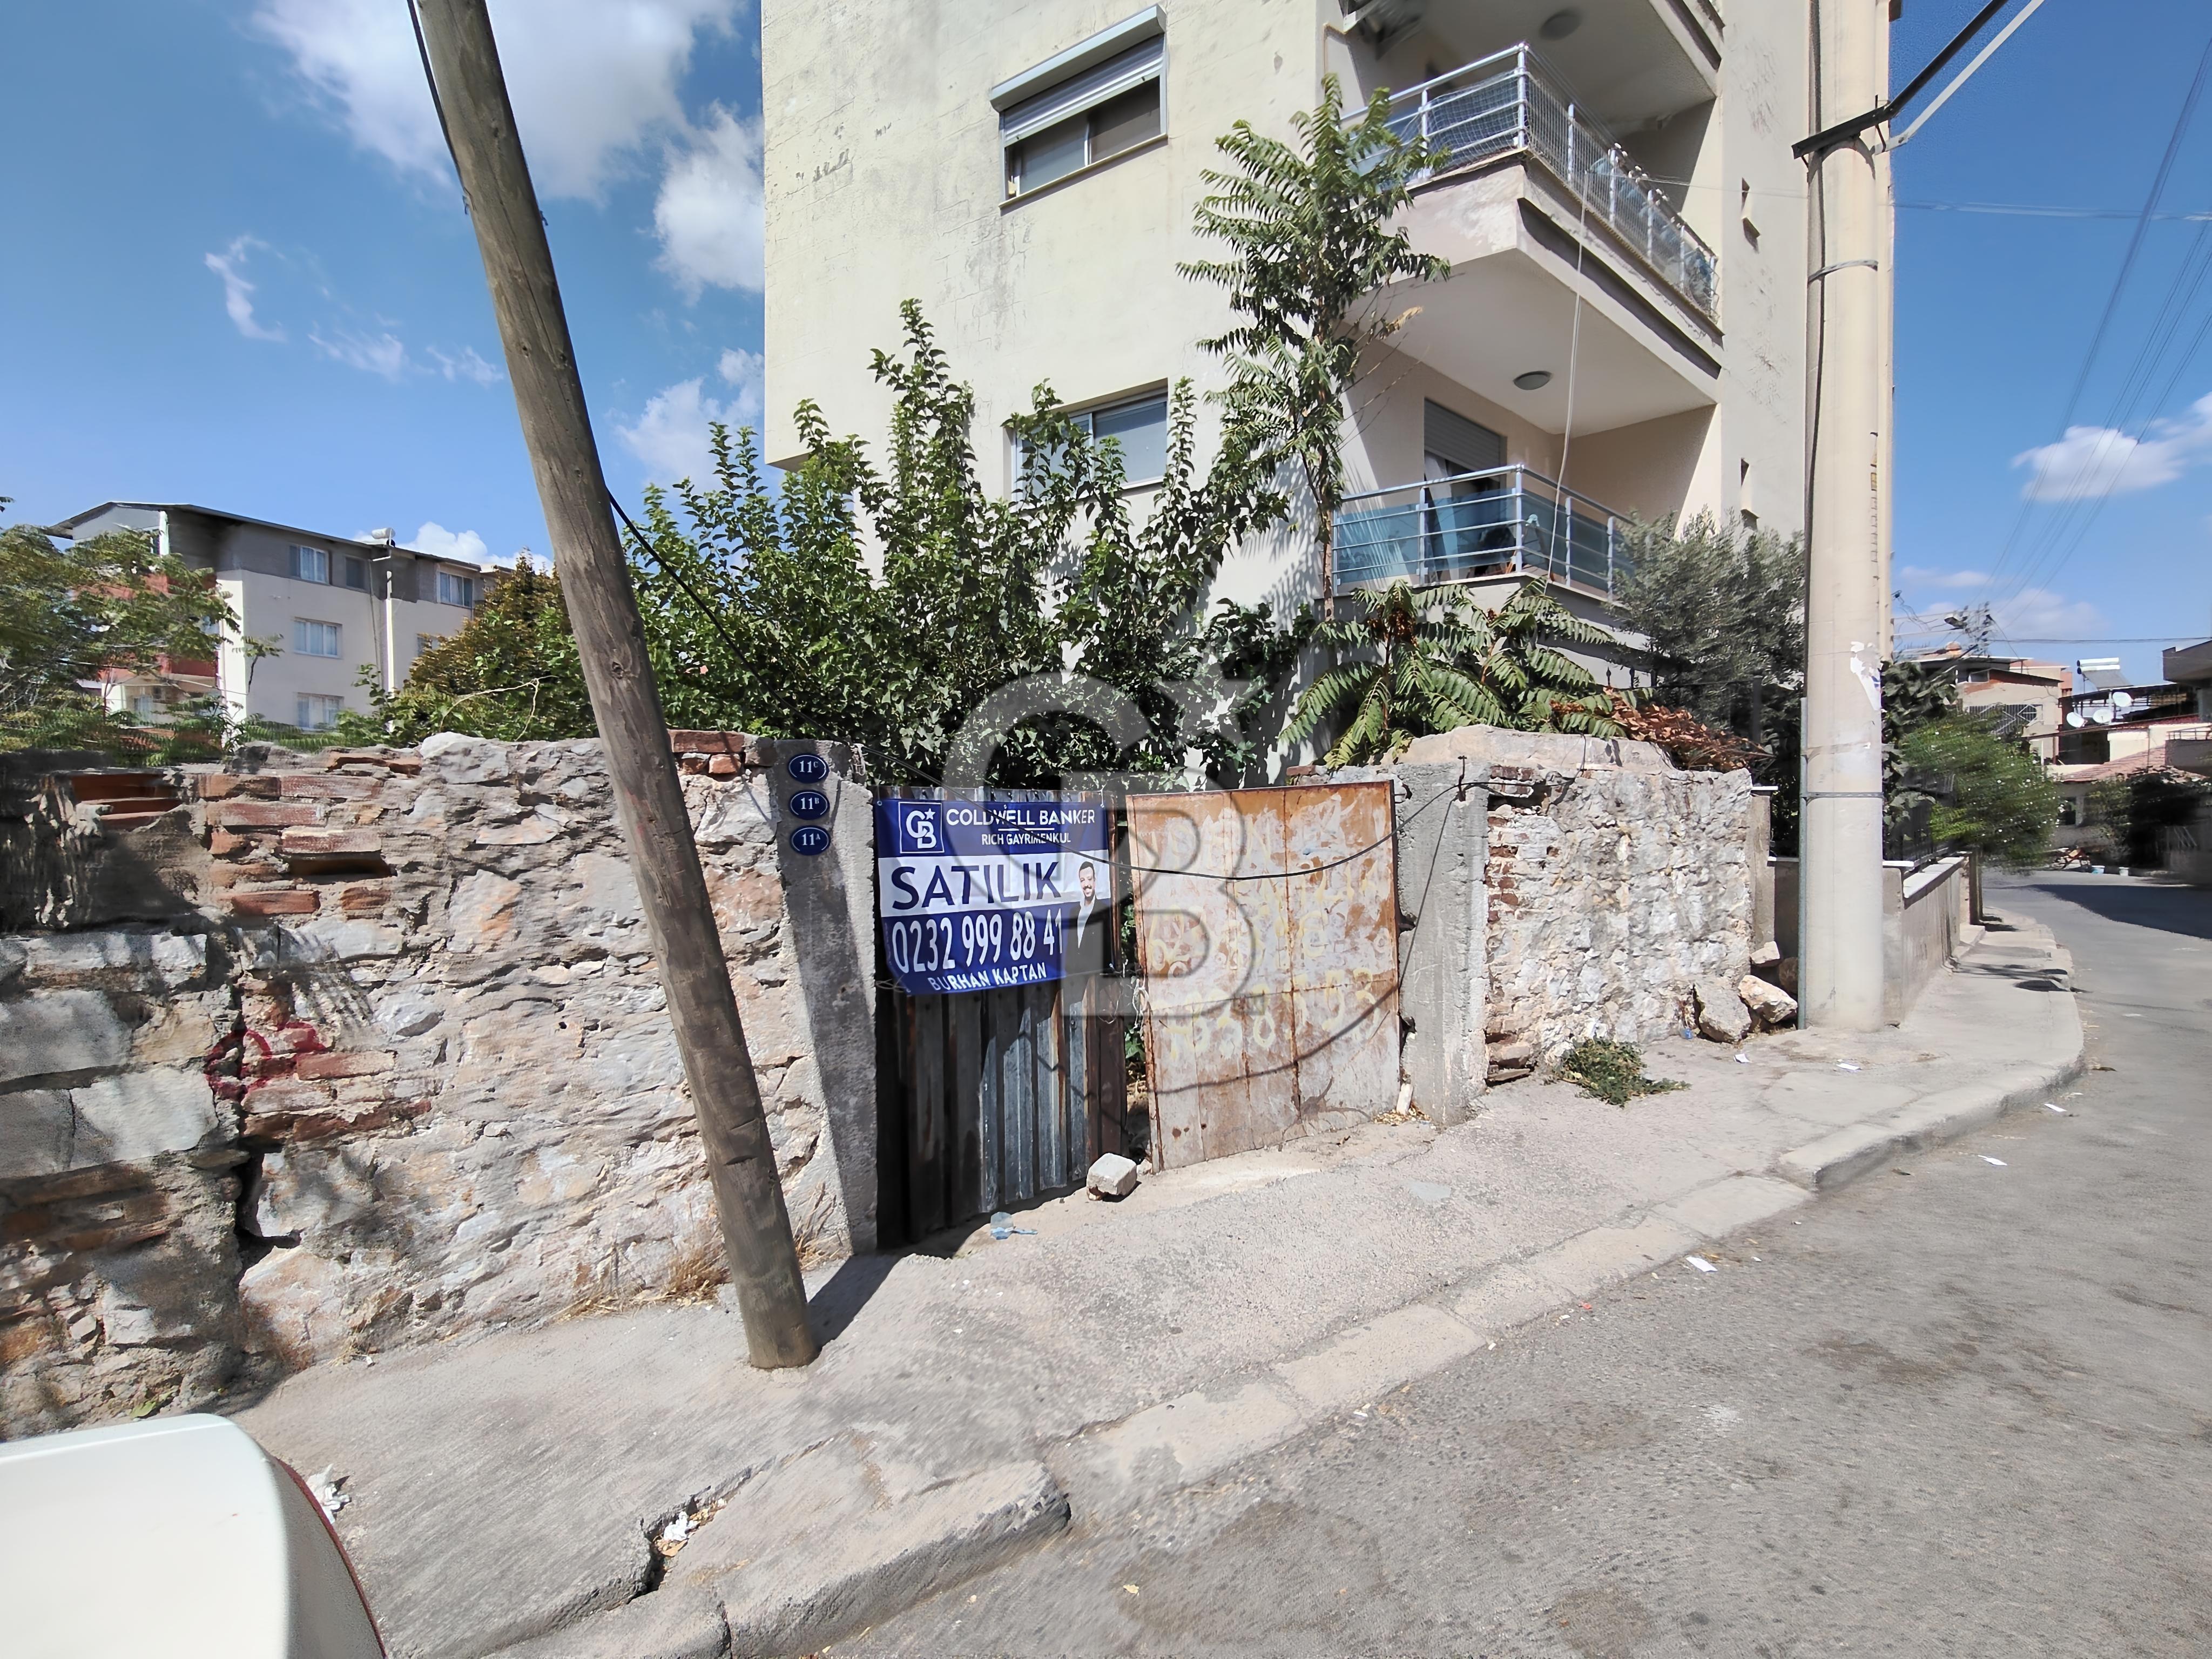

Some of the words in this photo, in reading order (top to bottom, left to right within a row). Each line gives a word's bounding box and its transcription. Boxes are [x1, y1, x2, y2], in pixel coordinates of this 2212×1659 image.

[799, 760, 819, 773] 11C
[800, 797, 819, 810] 11B
[946, 808, 1035, 826] COLDWELL
[1039, 809, 1095, 825] BANKER
[802, 833, 821, 846] 11A
[981, 833, 1003, 846] RICH
[891, 861, 1062, 911] SATILIK
[892, 918, 956, 974] 0232
[962, 914, 1002, 967] 999
[1010, 911, 1036, 961] 88
[1043, 908, 1063, 955] 41
[927, 970, 991, 992] BURHAN
[992, 962, 1047, 984] KAPTAN
